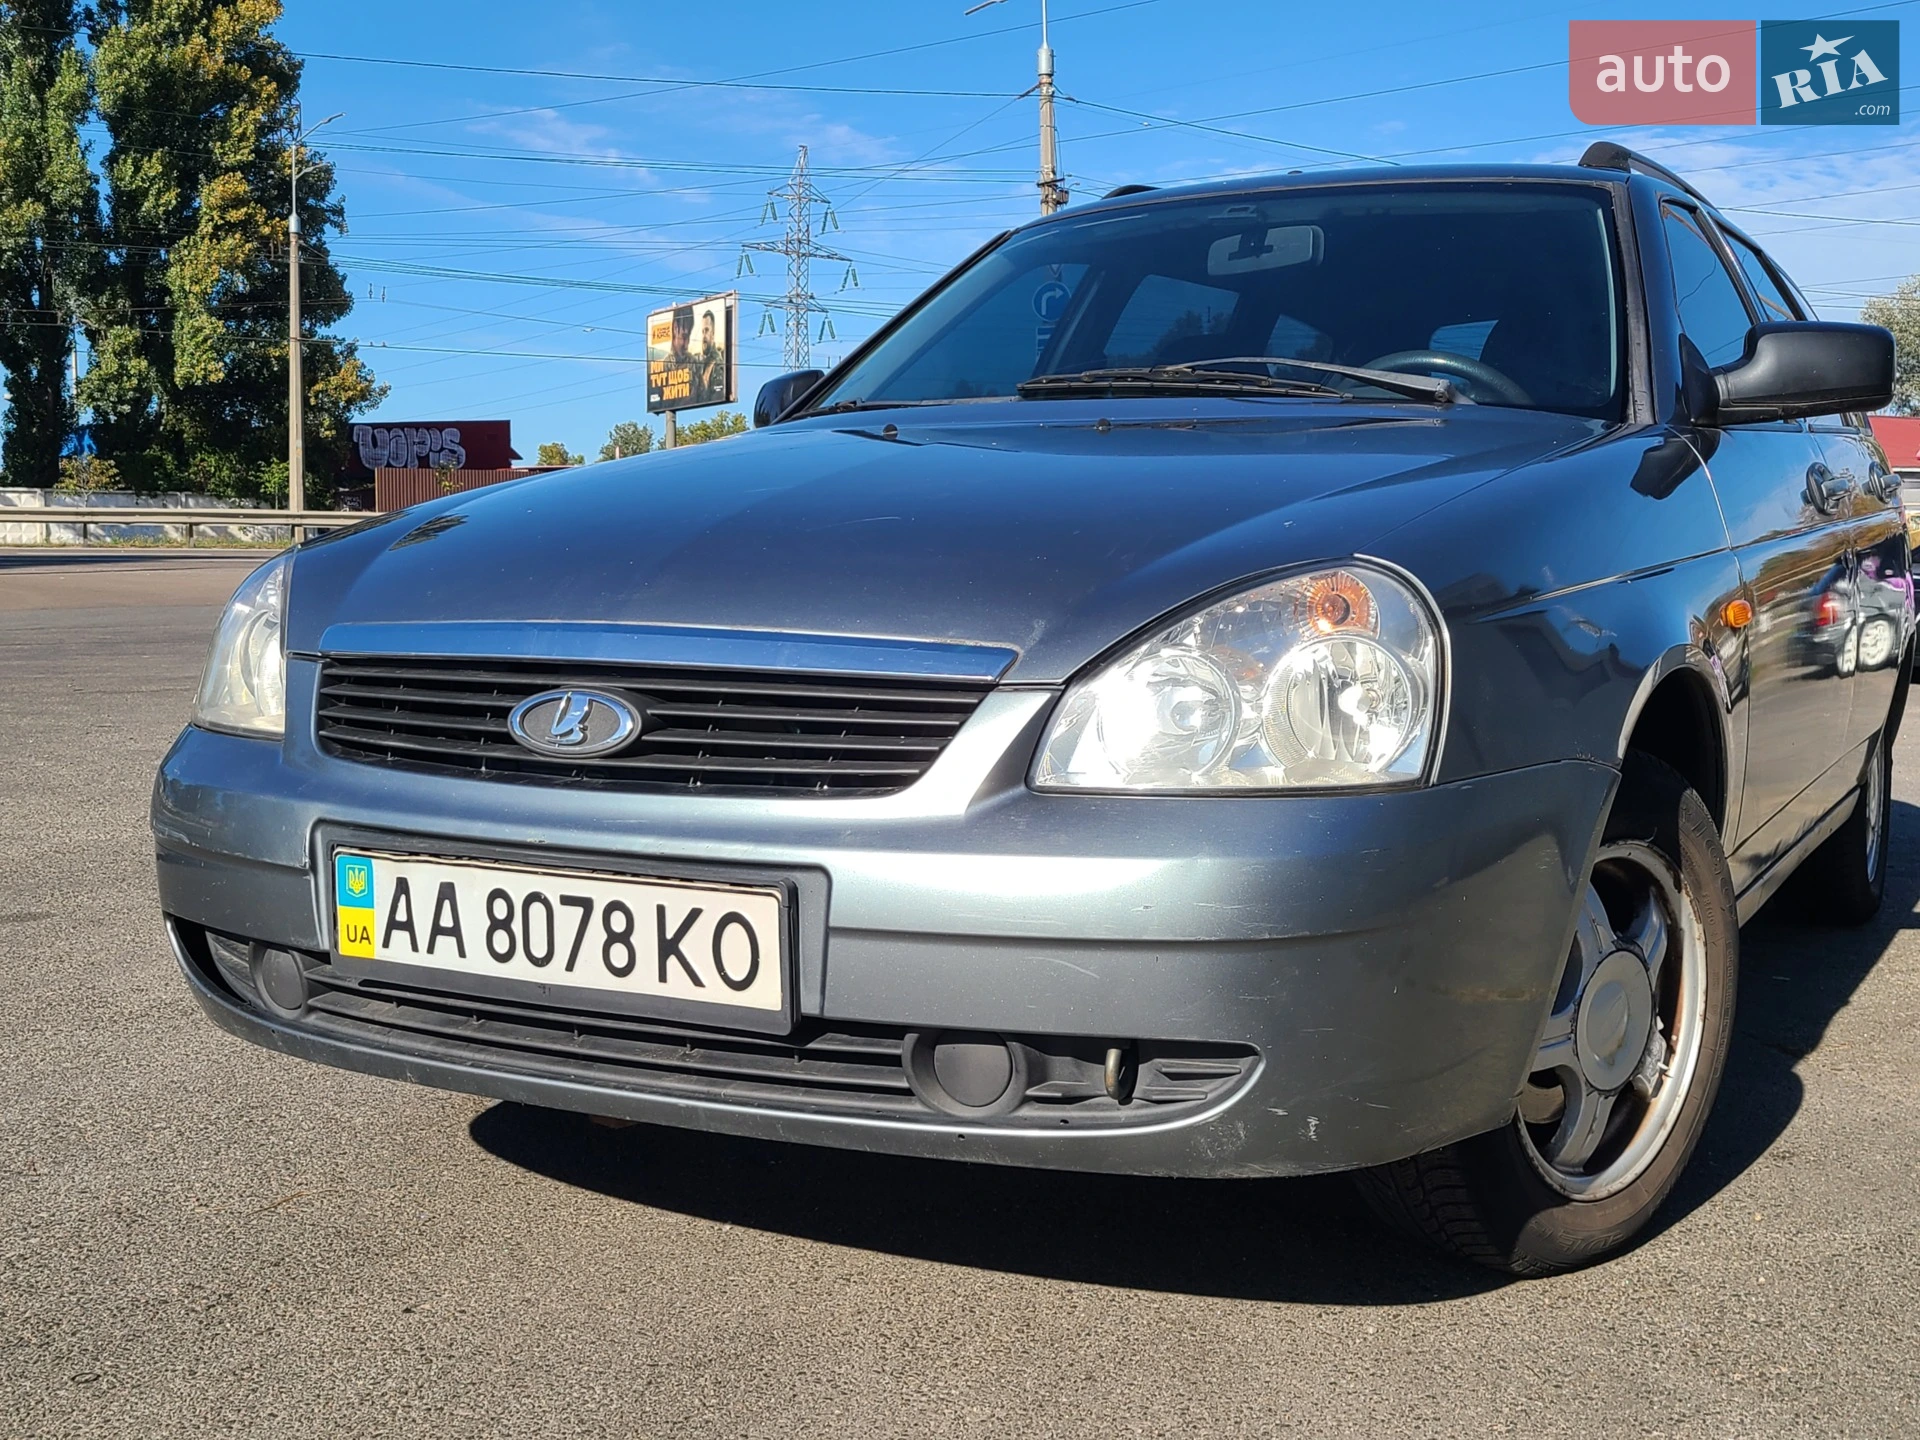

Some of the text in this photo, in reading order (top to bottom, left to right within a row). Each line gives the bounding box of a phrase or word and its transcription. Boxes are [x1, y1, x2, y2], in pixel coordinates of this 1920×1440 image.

[668, 368, 690, 386] ЩОБ
[663, 383, 690, 400] ЖИТИ
[346, 876, 760, 992] UA AA 8078 KO
